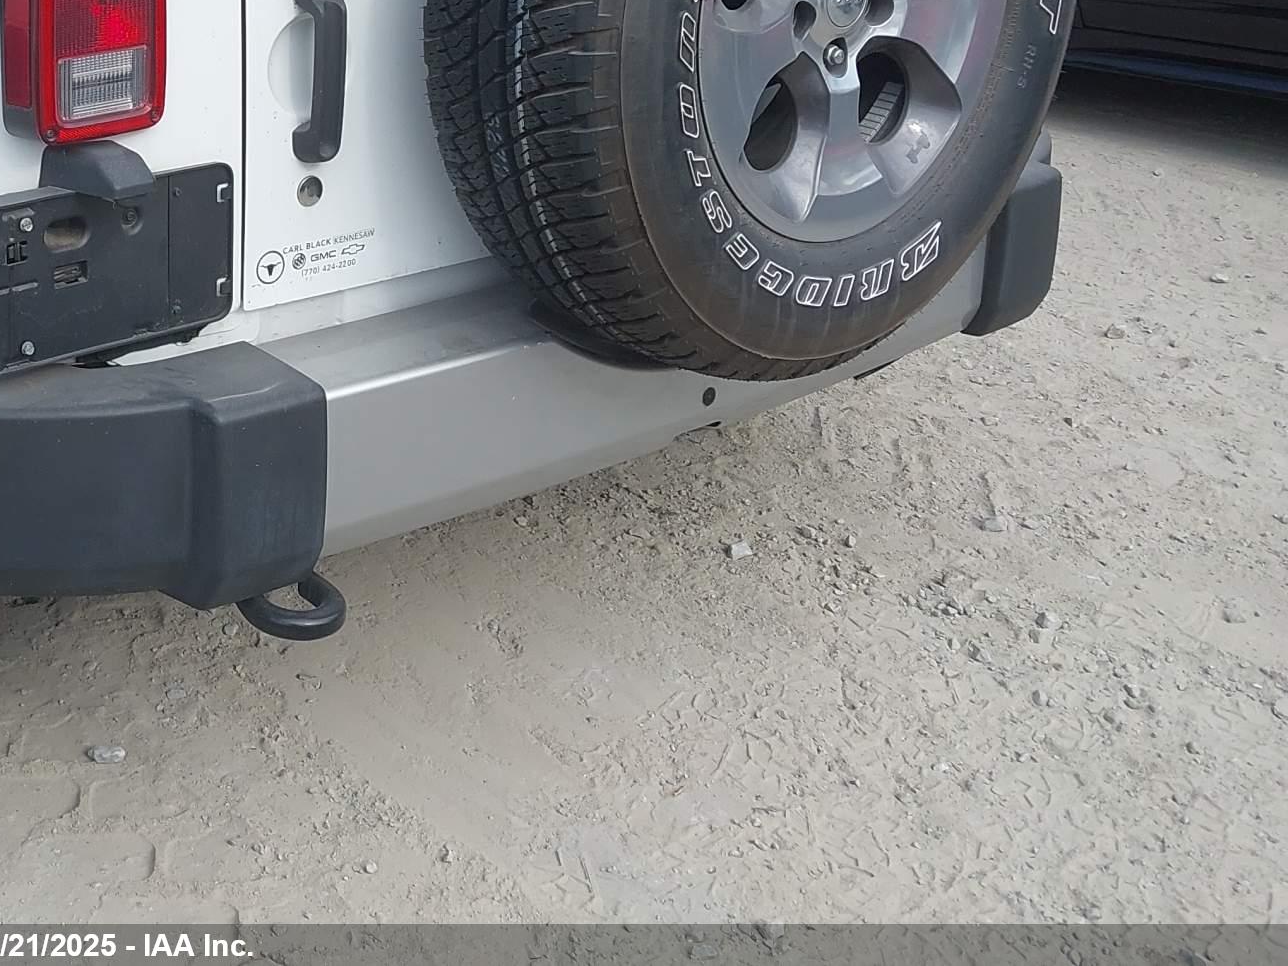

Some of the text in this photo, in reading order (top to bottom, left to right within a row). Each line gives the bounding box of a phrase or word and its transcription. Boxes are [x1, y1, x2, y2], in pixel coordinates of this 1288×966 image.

[282, 228, 375, 254] CARL BLACK KENNESAW
[310, 250, 337, 263] GMC
[301, 258, 356, 277] (770) 424-2200
